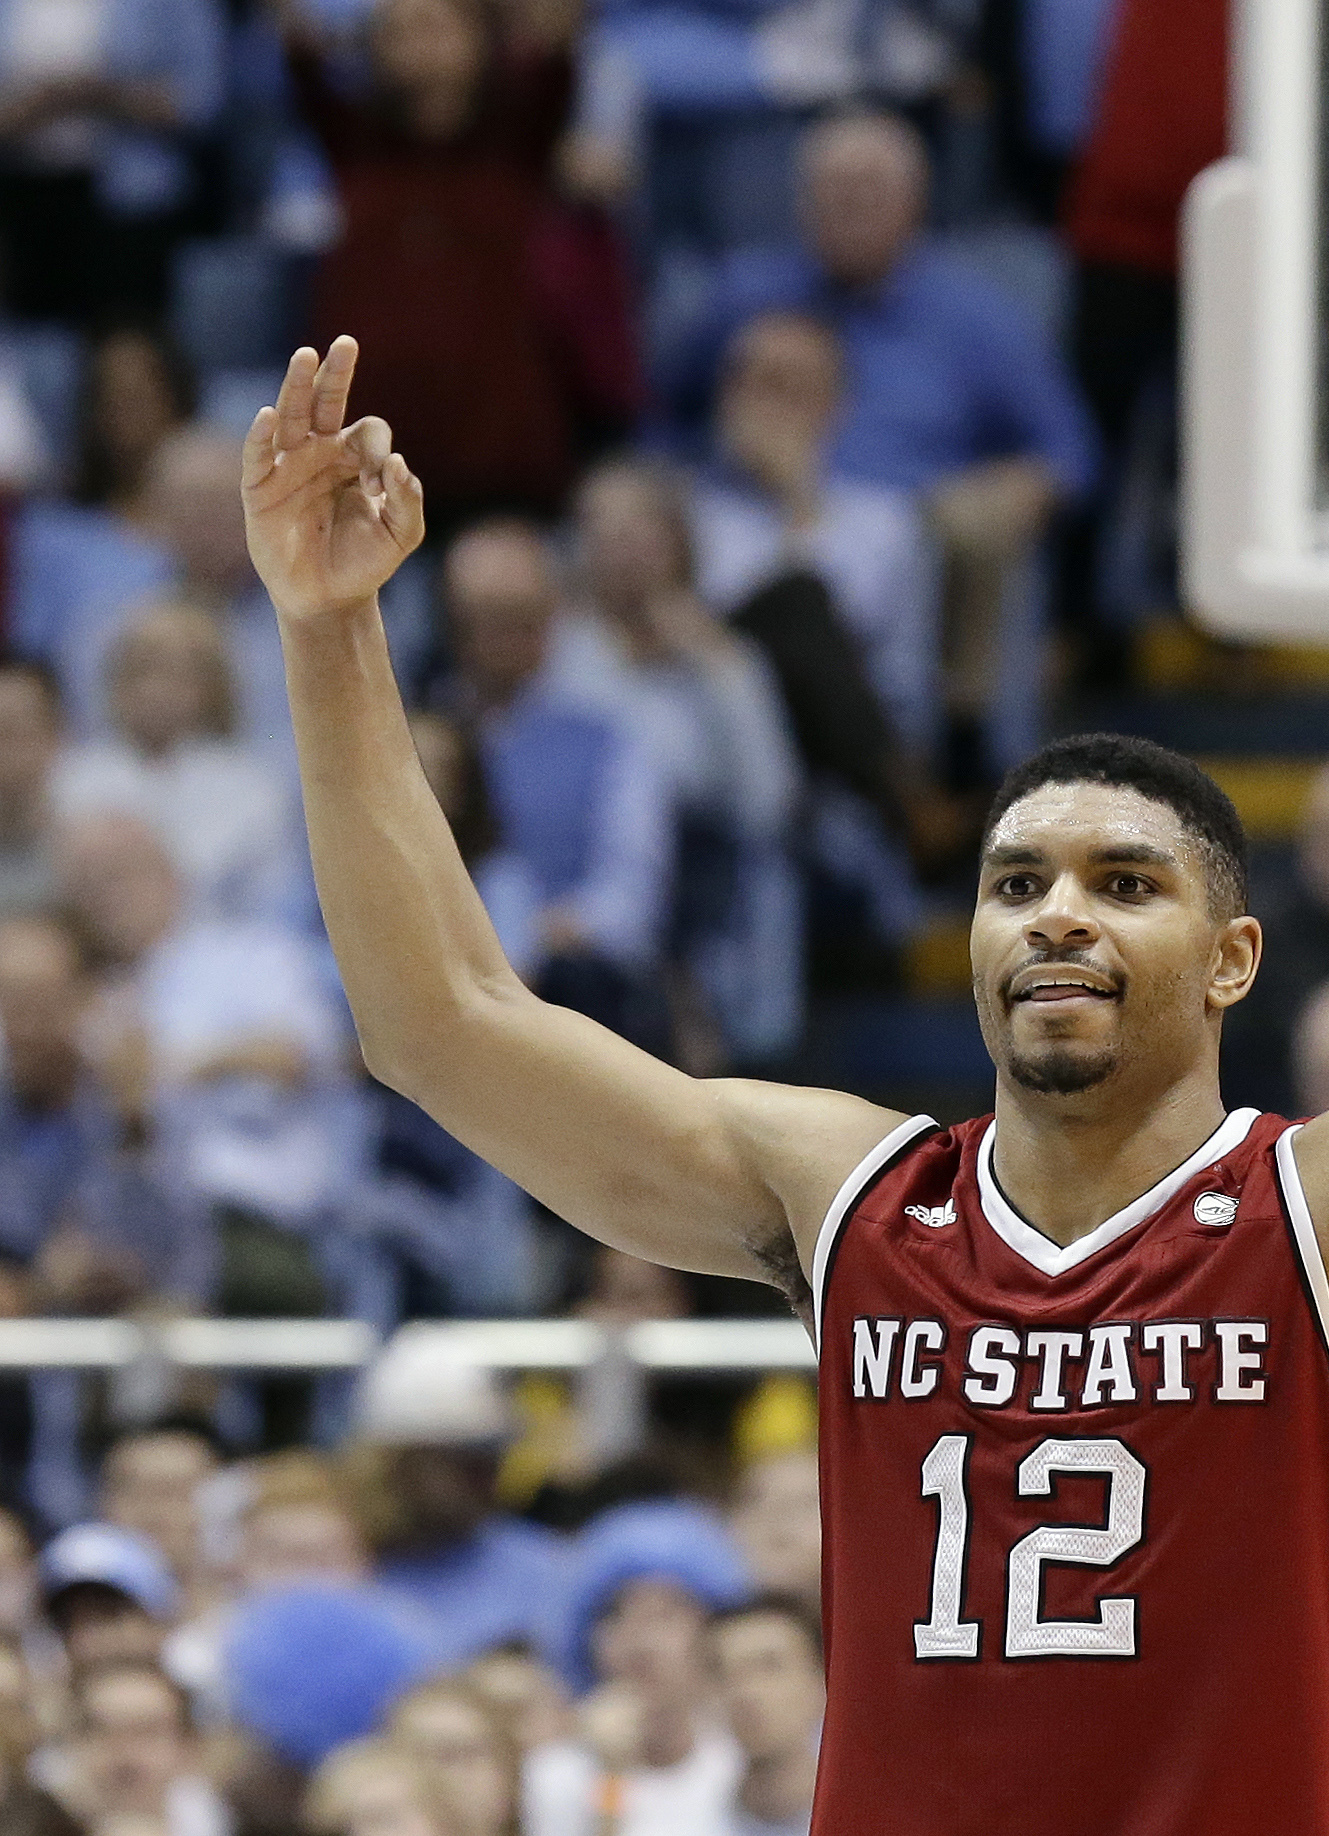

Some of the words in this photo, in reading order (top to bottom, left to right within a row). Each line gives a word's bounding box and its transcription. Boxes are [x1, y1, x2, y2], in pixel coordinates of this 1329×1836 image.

[851, 1317, 945, 1400] NC
[962, 1320, 1270, 1410] STATE
[911, 1434, 1147, 1660] 12
